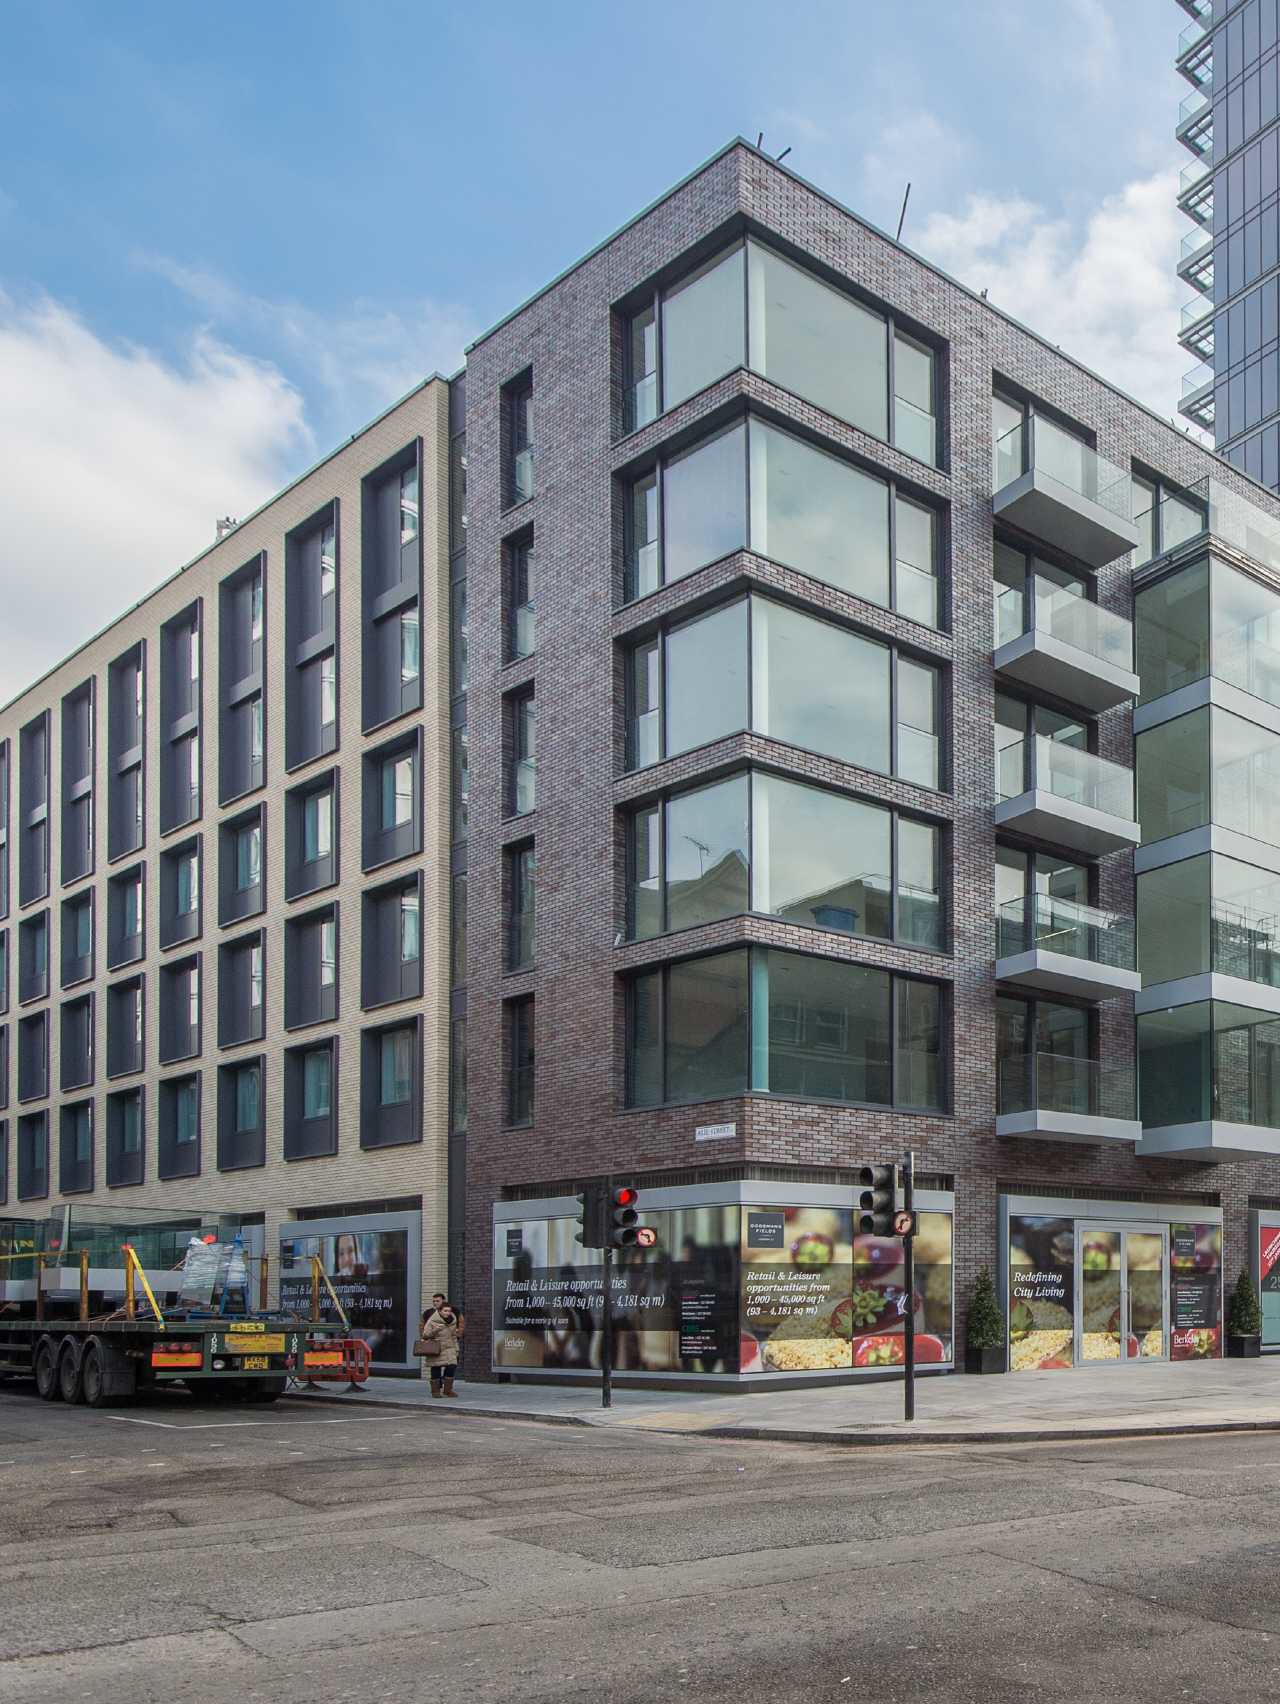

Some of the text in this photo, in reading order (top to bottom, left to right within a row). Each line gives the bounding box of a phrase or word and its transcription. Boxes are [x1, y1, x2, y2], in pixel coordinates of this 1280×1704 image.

[747, 1271, 820, 1280] Retail & Leisure
[1013, 1271, 1063, 1284] Redefining
[504, 1276, 627, 1292] Retail & Leisure opportuties
[746, 1283, 830, 1293] opportunities from
[1013, 1286, 1065, 1299] City Living
[504, 1296, 524, 1310] from
[526, 1296, 545, 1309] 1,000
[552, 1296, 576, 1309] 45,000
[576, 1298, 586, 1309] sq
[587, 1296, 595, 1309] ft
[616, 1295, 638, 1308] 4,181
[639, 1297, 651, 1309] sq
[652, 1294, 665, 1307] m)
[746, 1295, 771, 1304] 1,000
[779, 1294, 806, 1304] 45,000
[746, 1307, 761, 1317] (93
[769, 1306, 792, 1315] 4,181
[793, 1307, 803, 1315] sq
[805, 1306, 818, 1315] m)
